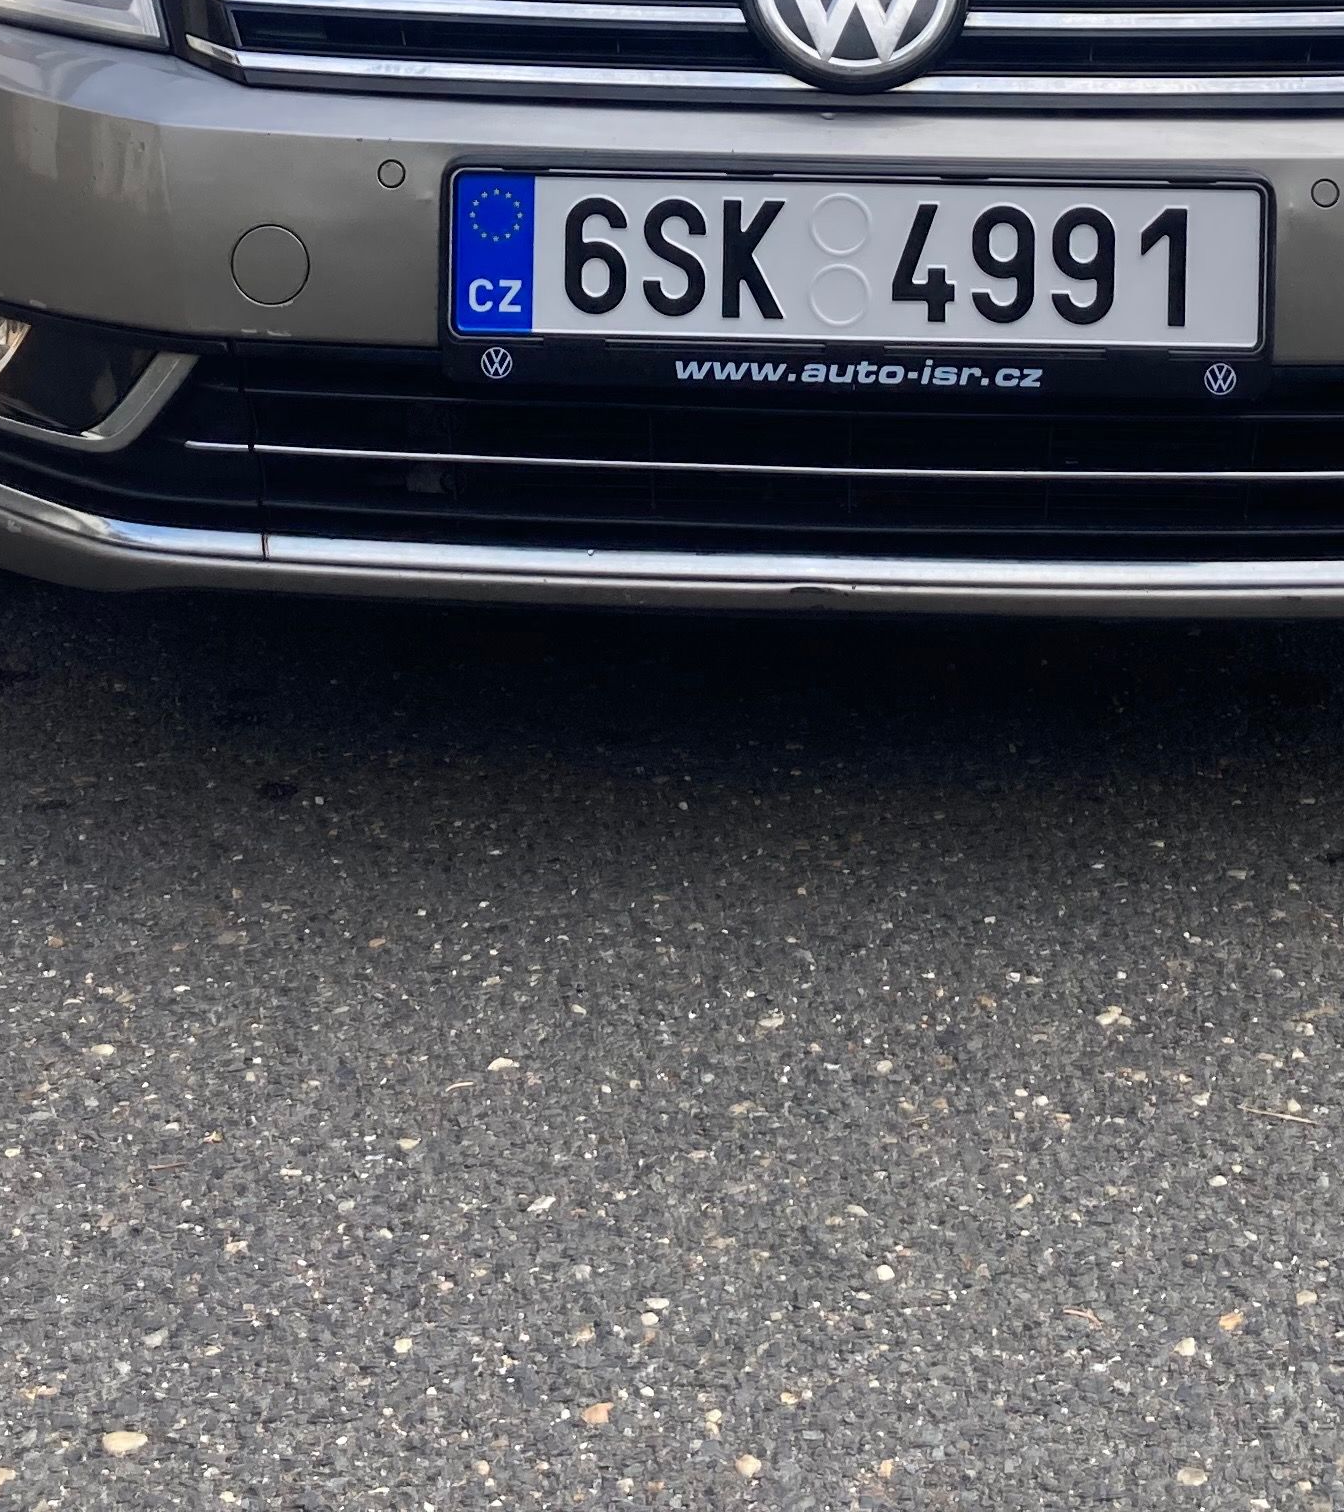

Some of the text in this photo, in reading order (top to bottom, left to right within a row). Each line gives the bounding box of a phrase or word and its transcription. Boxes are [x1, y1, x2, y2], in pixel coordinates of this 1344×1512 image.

[563, 197, 1190, 327] 6SK 4991
[467, 278, 523, 313] CZ
[481, 347, 513, 379] VW
[675, 359, 1043, 387] www.auto-isr.cz
[1204, 363, 1237, 396] VW
